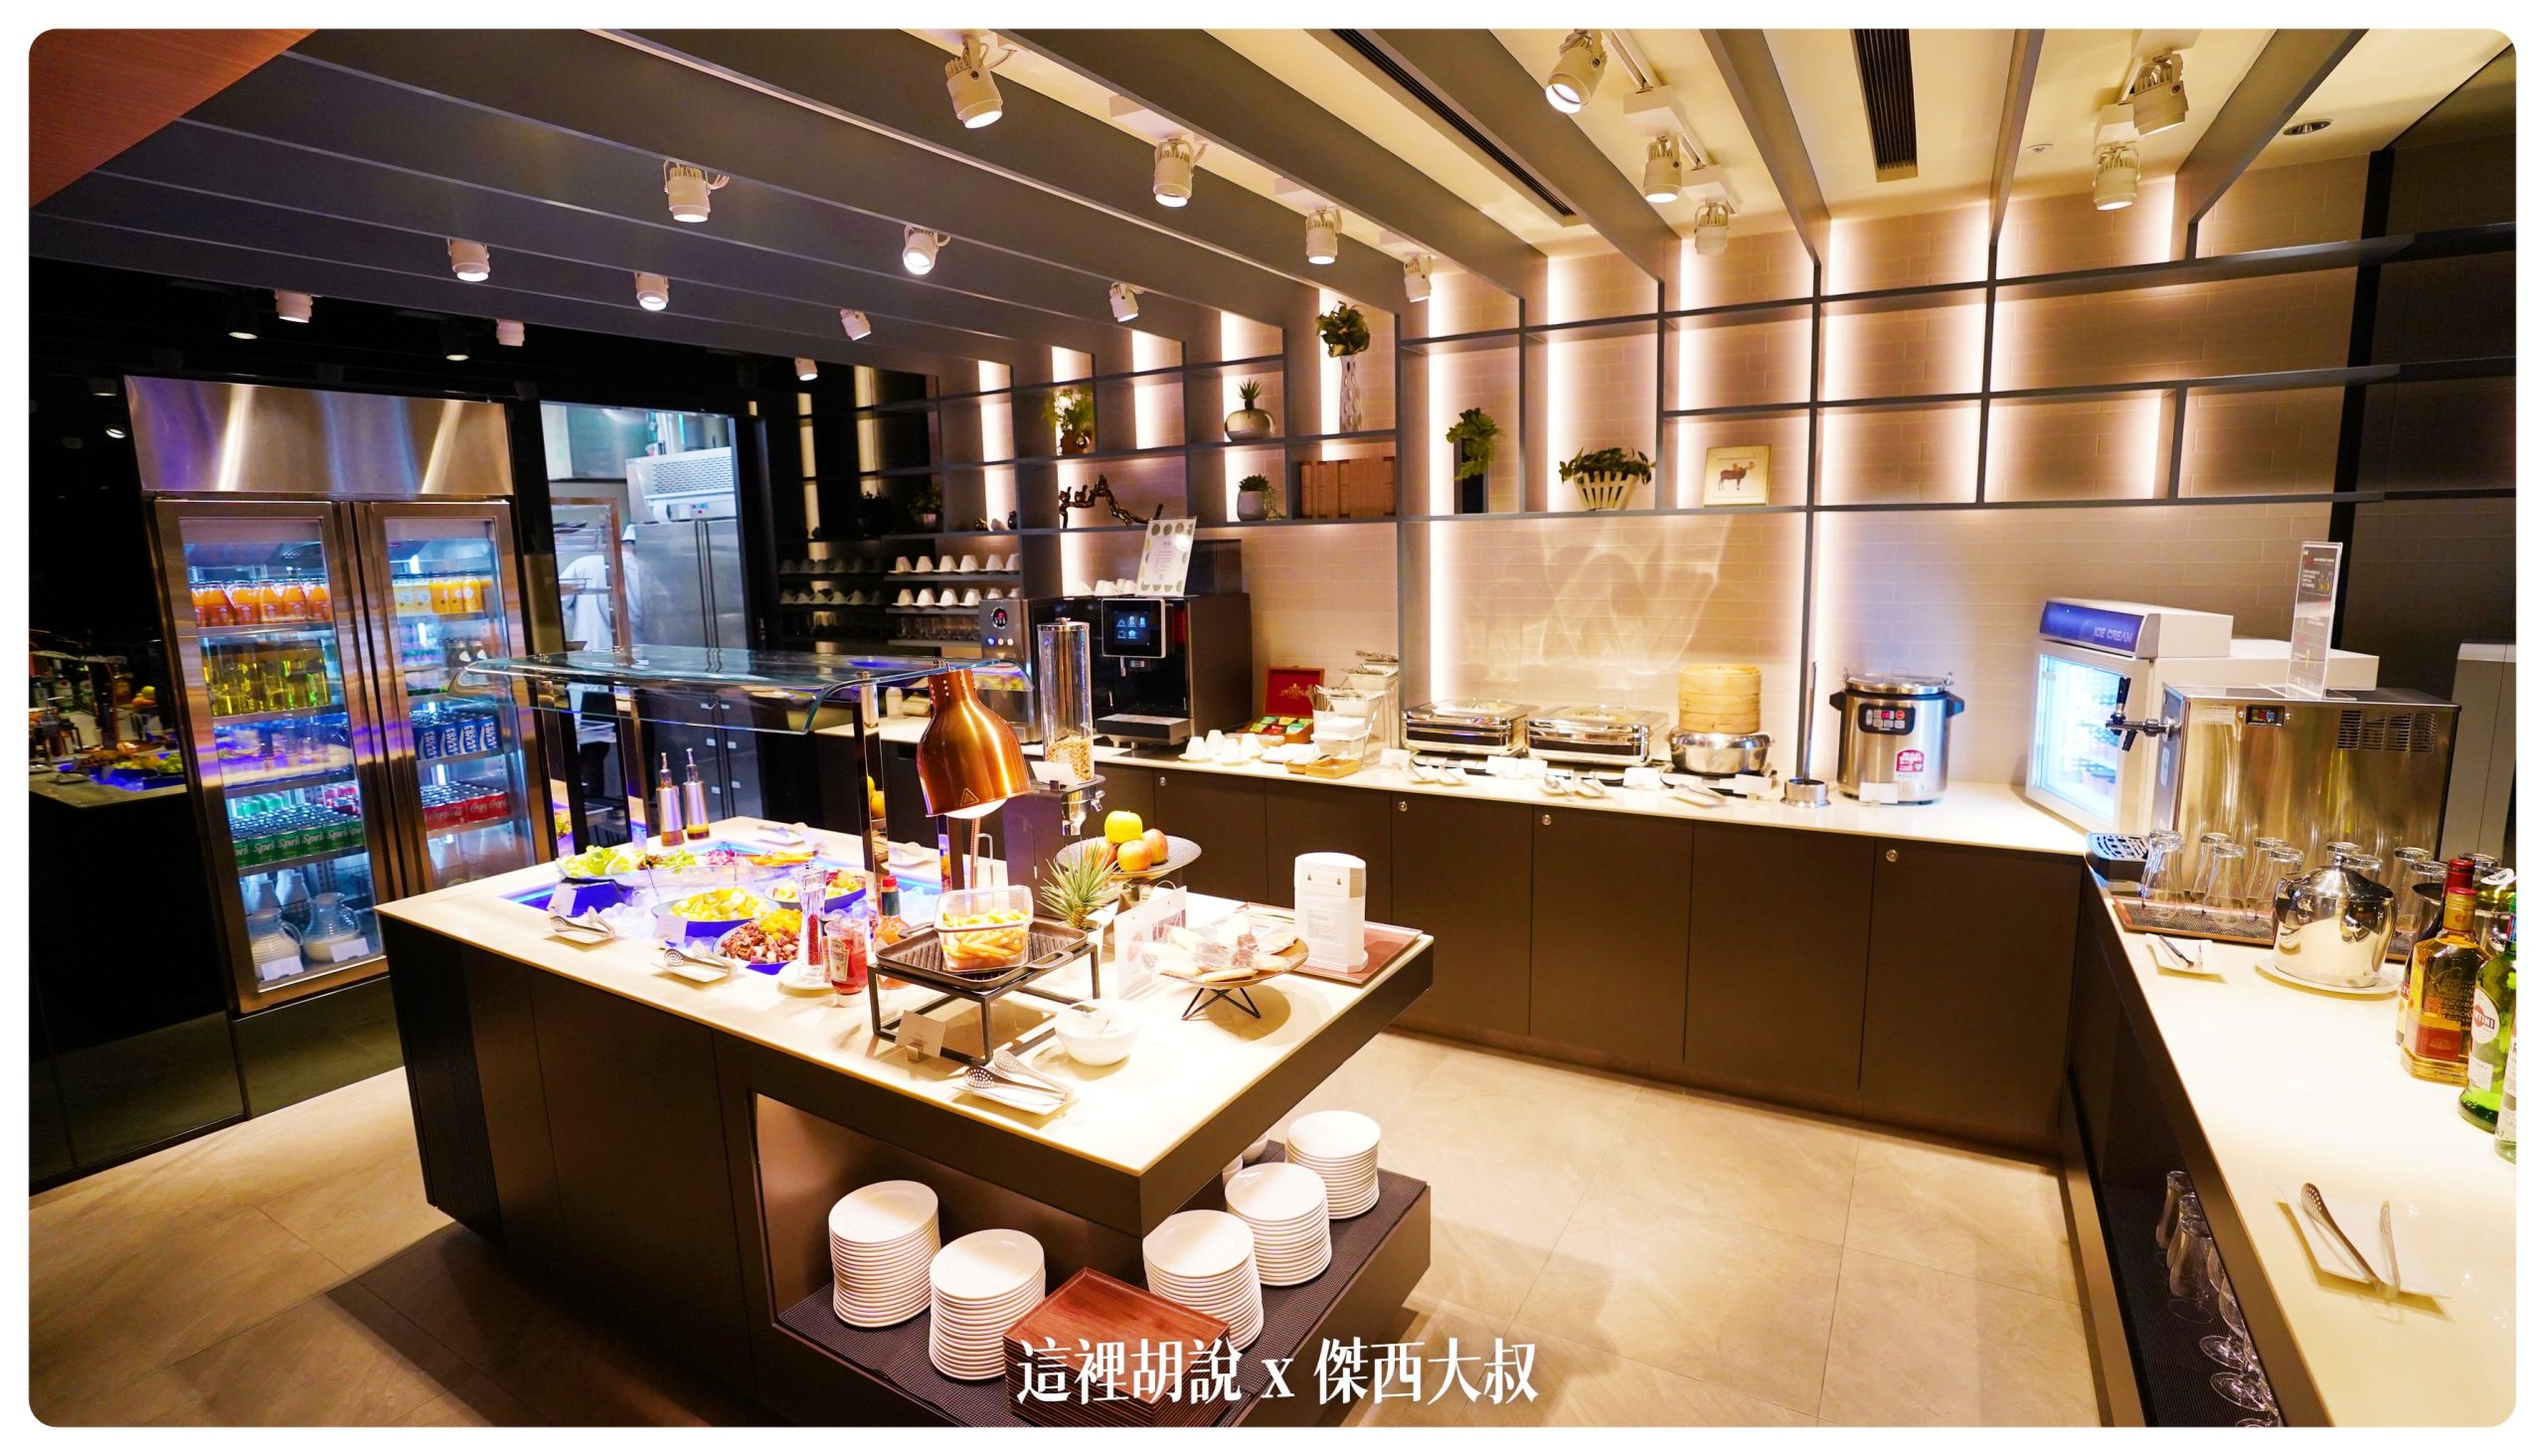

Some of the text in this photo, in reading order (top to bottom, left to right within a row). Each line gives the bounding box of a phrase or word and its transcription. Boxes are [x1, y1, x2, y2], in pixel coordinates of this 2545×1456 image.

[2093, 626, 2134, 644] ICE CREAM
[278, 836, 300, 850] Spri
[302, 831, 325, 845] Spri
[254, 840, 274, 855] Spri
